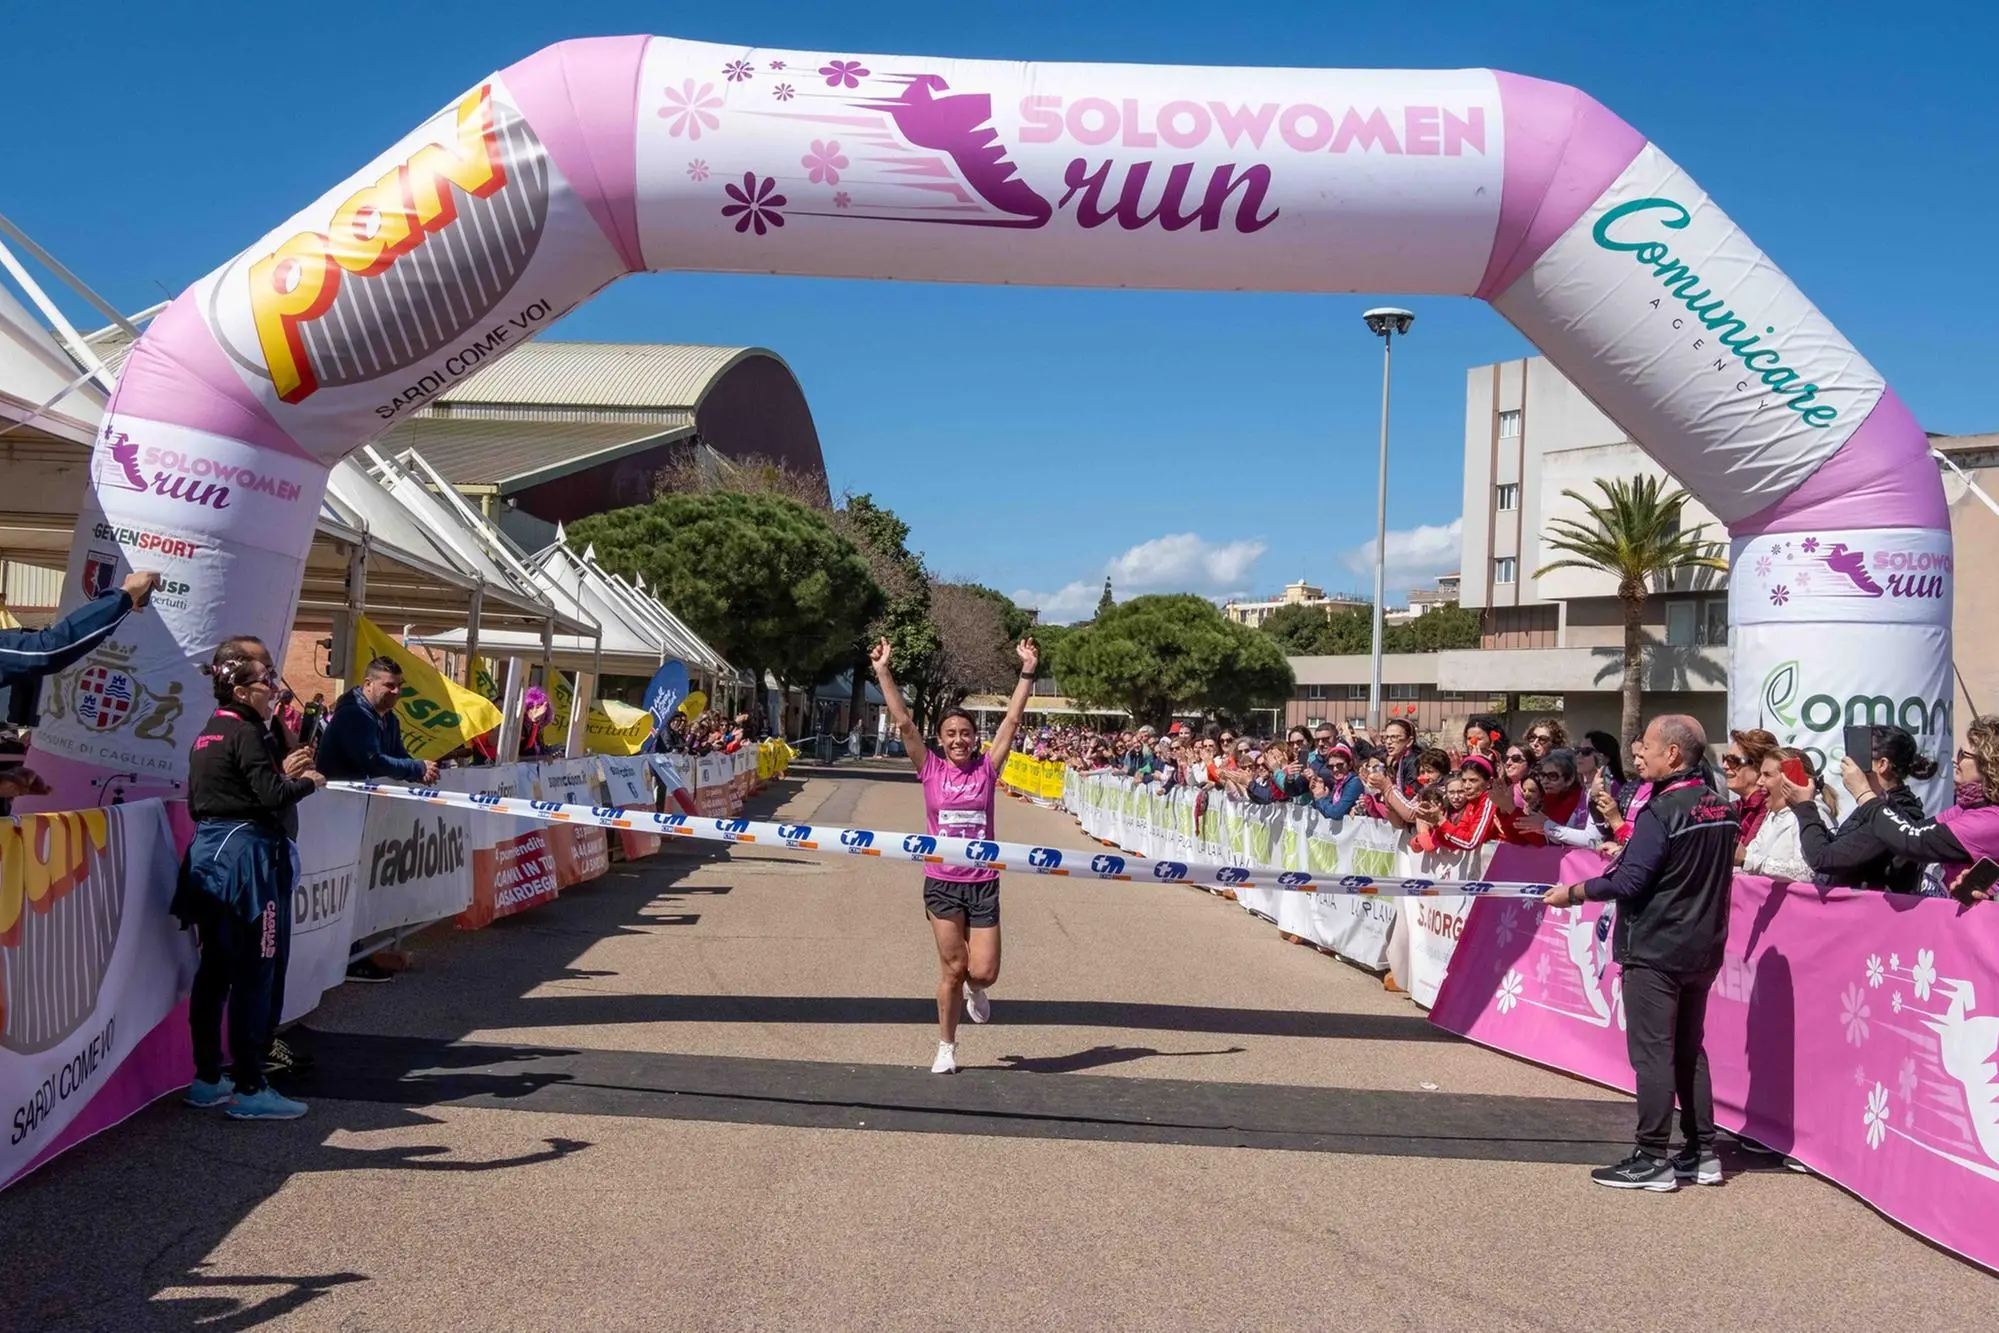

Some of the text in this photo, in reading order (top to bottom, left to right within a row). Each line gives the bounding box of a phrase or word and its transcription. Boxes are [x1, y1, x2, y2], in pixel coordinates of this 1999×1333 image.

[1019, 95, 1486, 157] SOLOWOMEN
[1058, 157, 1280, 233] run
[1592, 198, 1838, 428] Comunicare
[375, 298, 553, 420] SARDI COME VOI
[1649, 297, 1769, 411] AGENCY
[144, 446, 302, 502] SOLOWOMEN
[150, 471, 230, 509] run
[93, 522, 198, 559] GEVENSPORT
[1886, 573, 1944, 599] run
[80, 743, 93, 754] DI
[99, 748, 173, 771] CAGLIARI
[369, 815, 465, 891] radiolina
[11, 1073, 56, 1146] SARDI
[60, 1035, 101, 1100] COME
